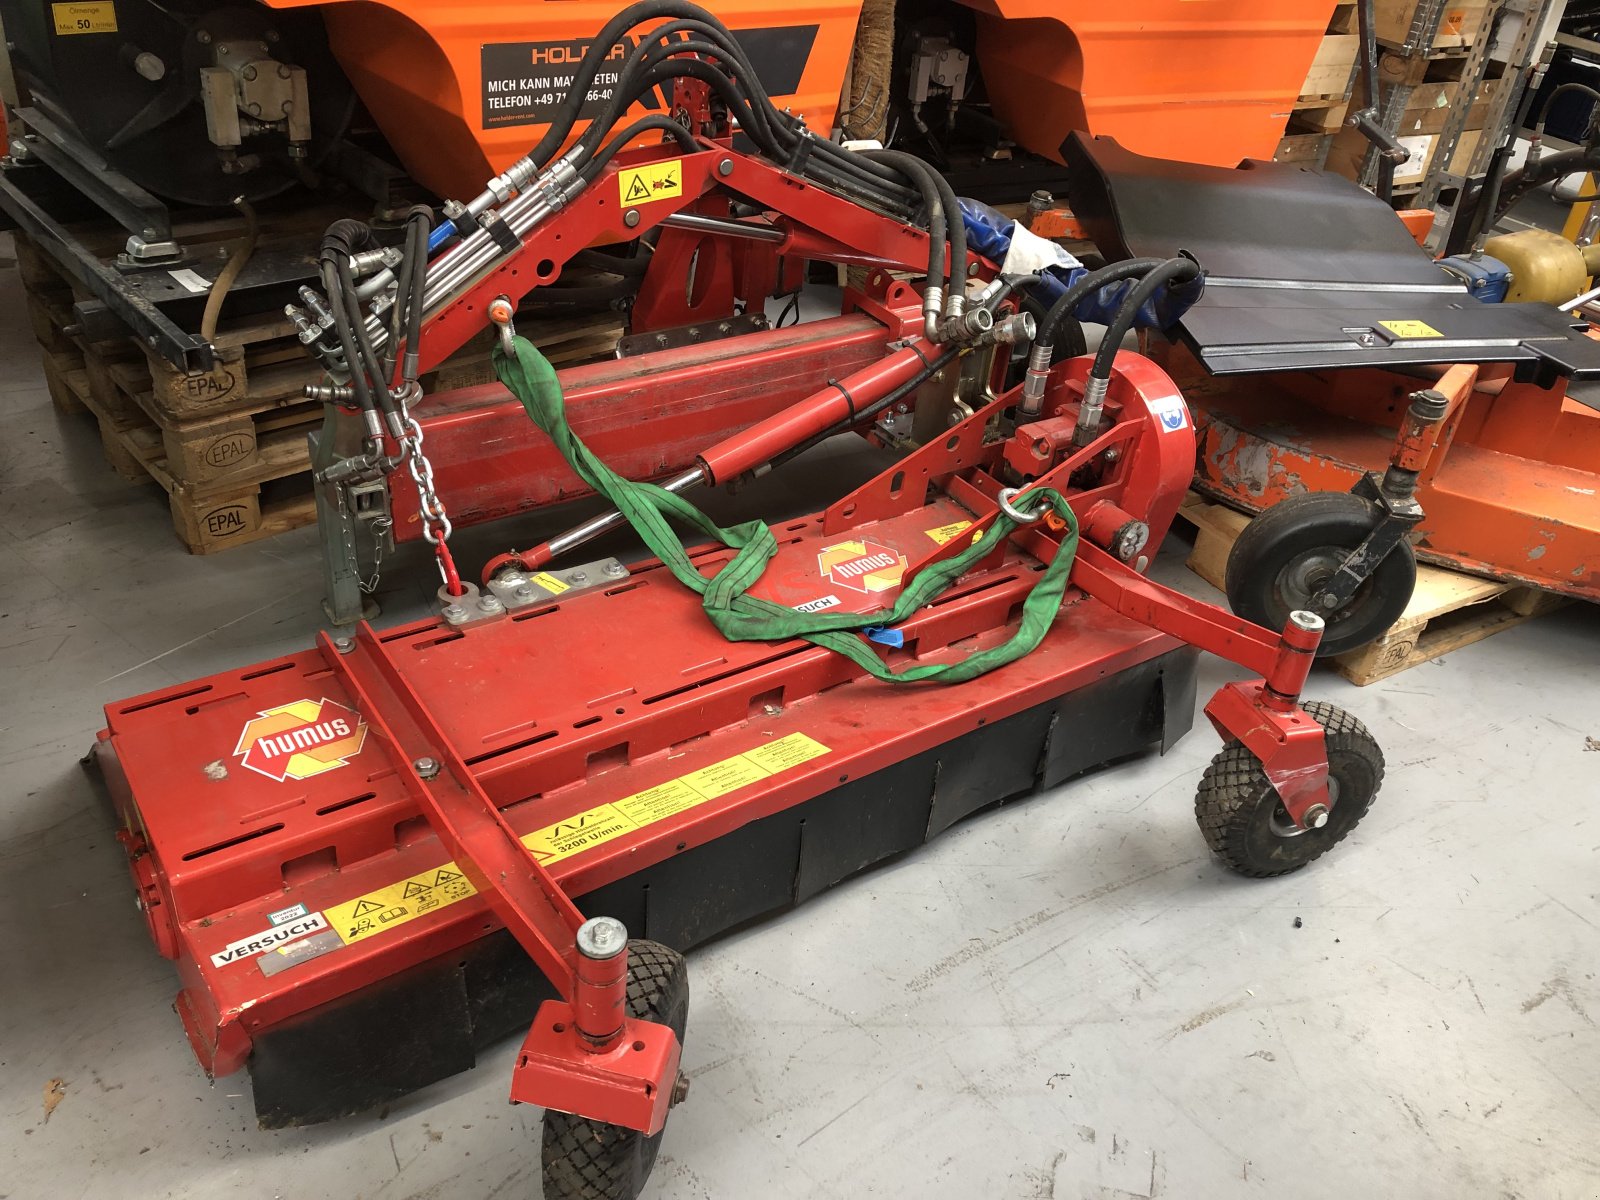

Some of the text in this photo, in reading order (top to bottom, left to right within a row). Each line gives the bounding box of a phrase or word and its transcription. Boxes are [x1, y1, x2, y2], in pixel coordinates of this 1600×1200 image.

[77, 19, 91, 29] 50
[488, 78, 516, 92] MICH
[520, 77, 550, 90] KANN
[553, 75, 575, 88] MA
[488, 94, 532, 109] TELEFON
[534, 92, 553, 106] +49
[212, 438, 249, 464] EPAL
[207, 510, 246, 533] EPAL
[832, 553, 896, 579] humus
[797, 598, 833, 613] SUCH
[257, 718, 351, 759] humus
[558, 837, 588, 853] 3200
[218, 919, 320, 962] VERSUCH
